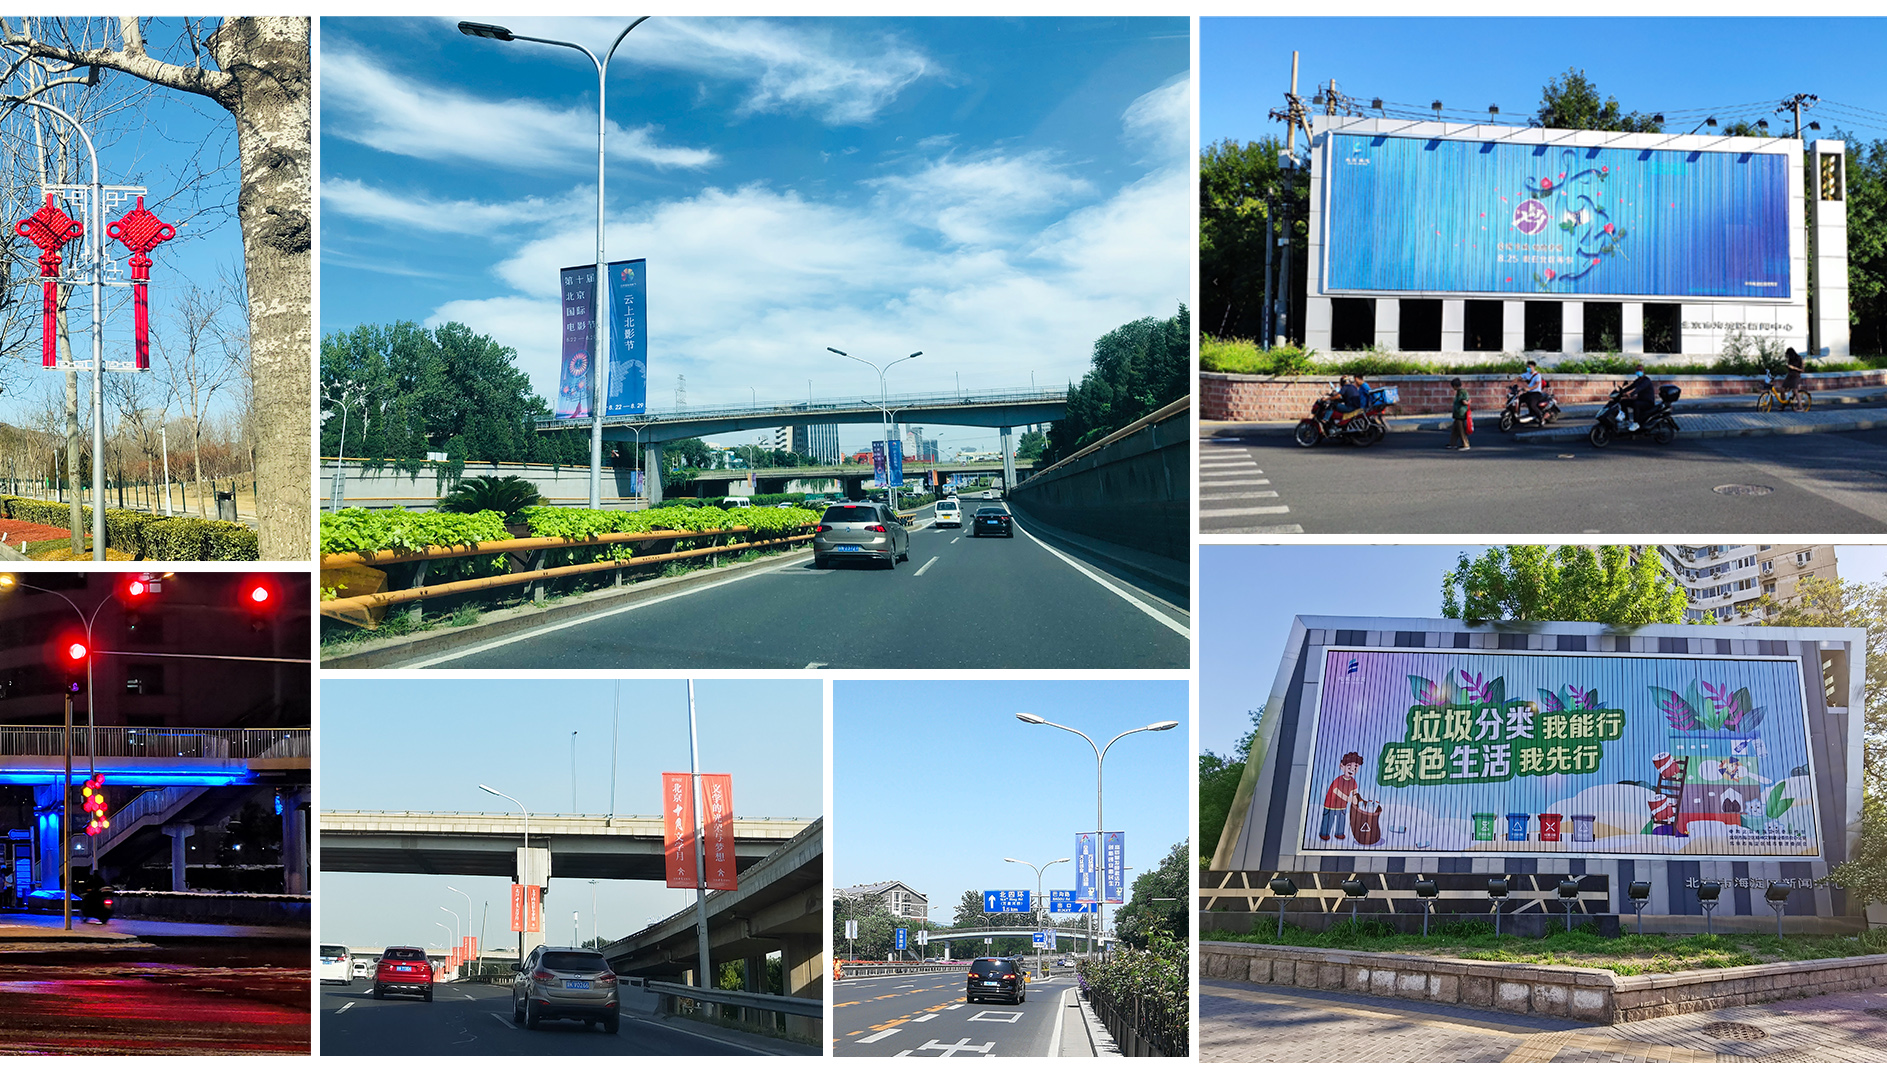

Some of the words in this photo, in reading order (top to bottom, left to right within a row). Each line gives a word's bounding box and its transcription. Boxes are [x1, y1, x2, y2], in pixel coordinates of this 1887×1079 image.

[564, 273, 595, 287] 第十届
[565, 290, 586, 302] 北京
[566, 306, 586, 317] 国际
[566, 320, 596, 333] 电影节
[623, 294, 635, 351] 云上北影节
[1411, 705, 1535, 743] 垃圾分类
[1542, 711, 1622, 741] 我能行
[1383, 743, 1512, 783] 绿色生活
[1519, 744, 1600, 773] 我先行
